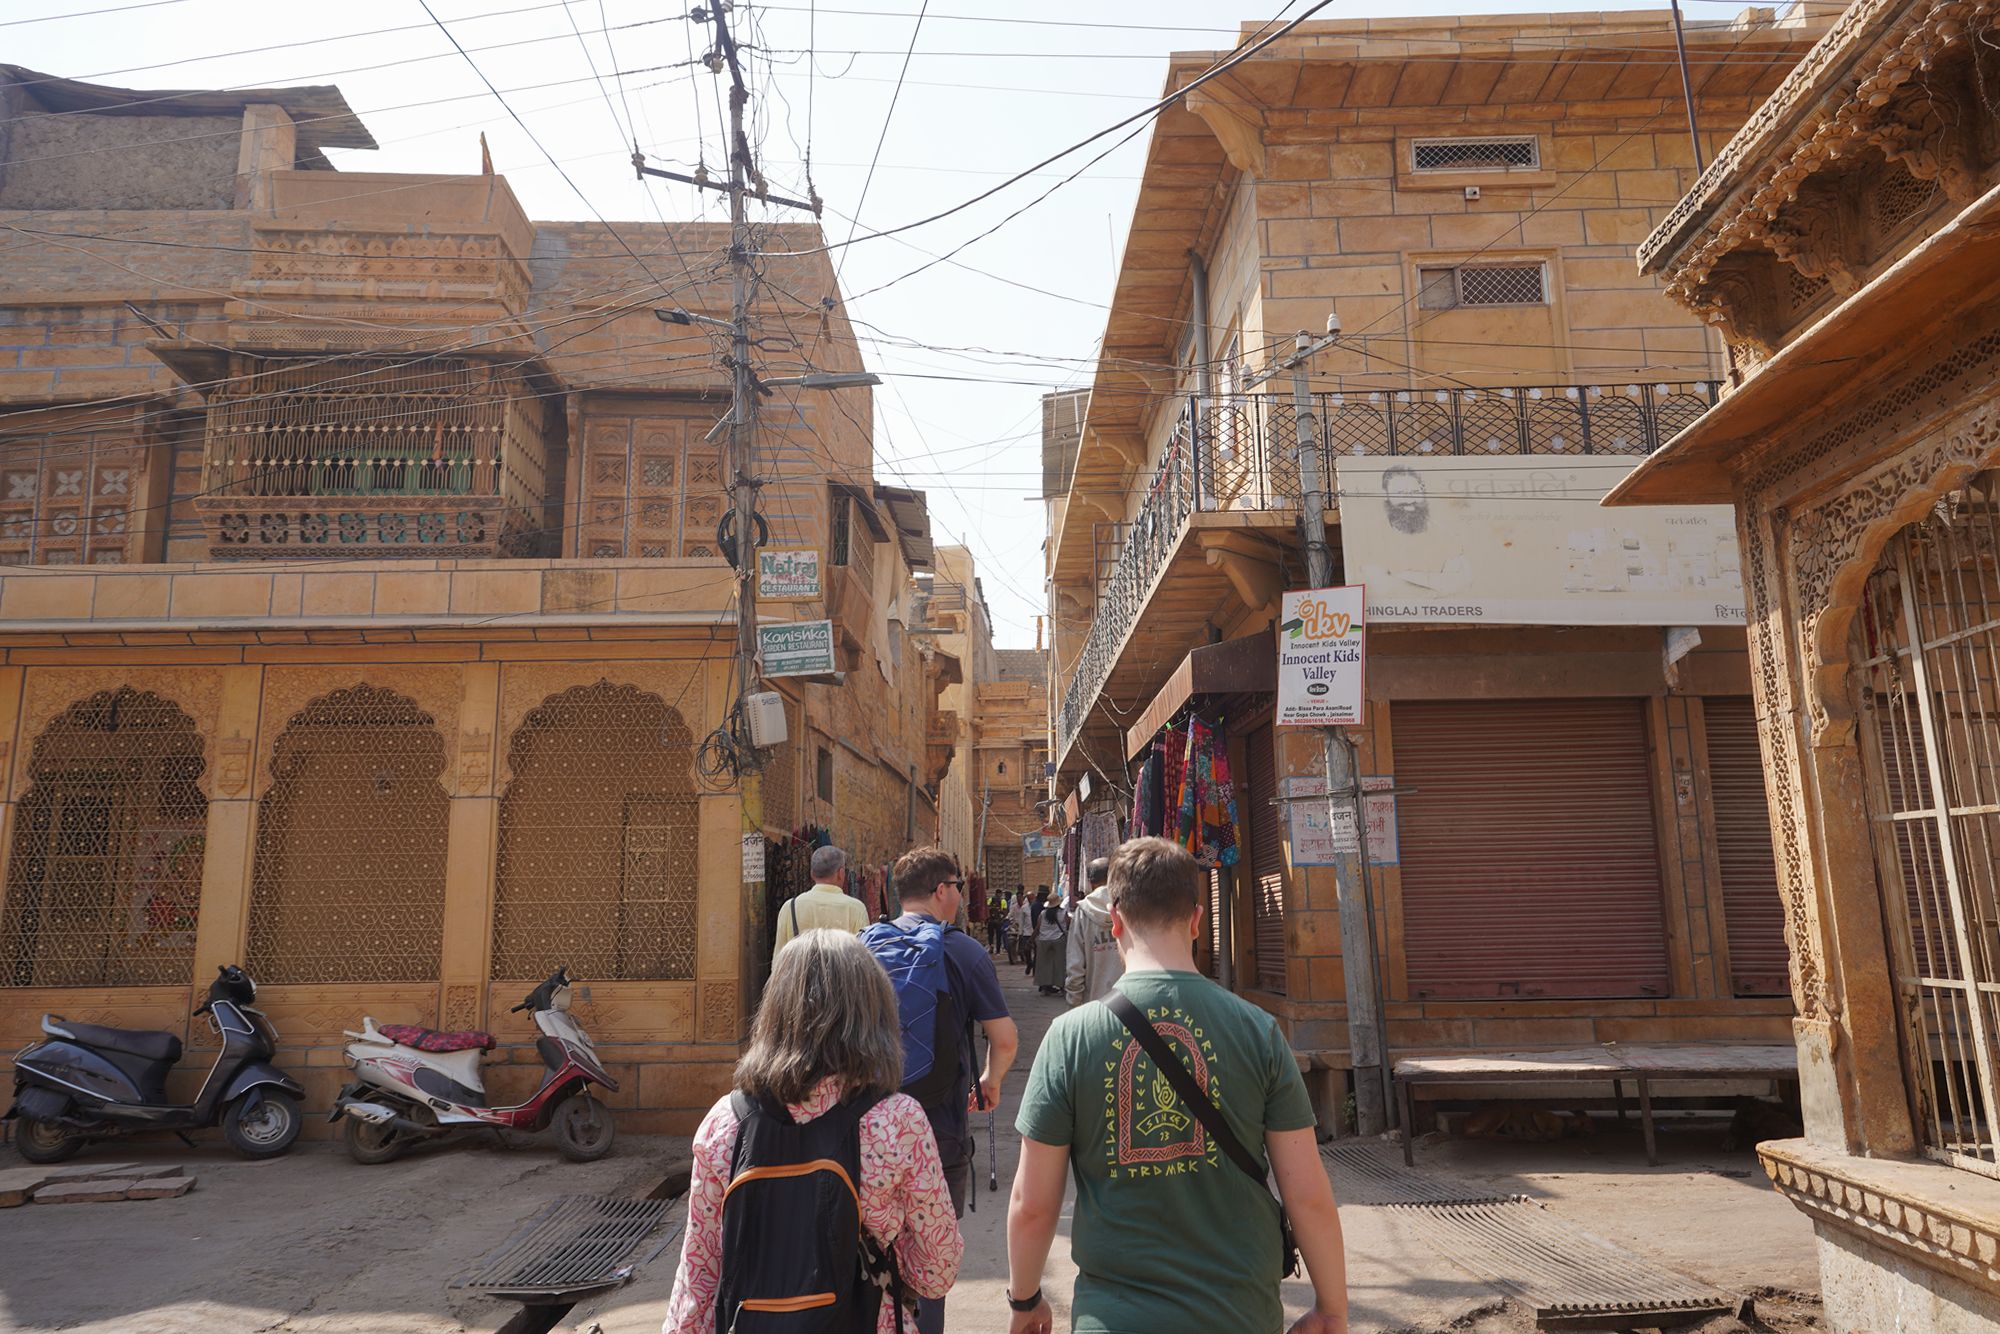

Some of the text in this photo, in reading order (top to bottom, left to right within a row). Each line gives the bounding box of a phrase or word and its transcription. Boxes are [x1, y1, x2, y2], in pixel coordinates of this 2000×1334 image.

[761, 584, 817, 592] RESTAURANT
[1421, 606, 1483, 616] TRADERS
[763, 629, 829, 644] Kanishka
[788, 640, 828, 650] RESTAURANT
[1290, 640, 1360, 650] Innocent Kids Valley
[1281, 649, 1360, 666] Innocent Kids
[1302, 666, 1337, 683] Valley
[1112, 1005, 1218, 1063] BORDSHORT
[1127, 1160, 1199, 1178] TRDMRK
